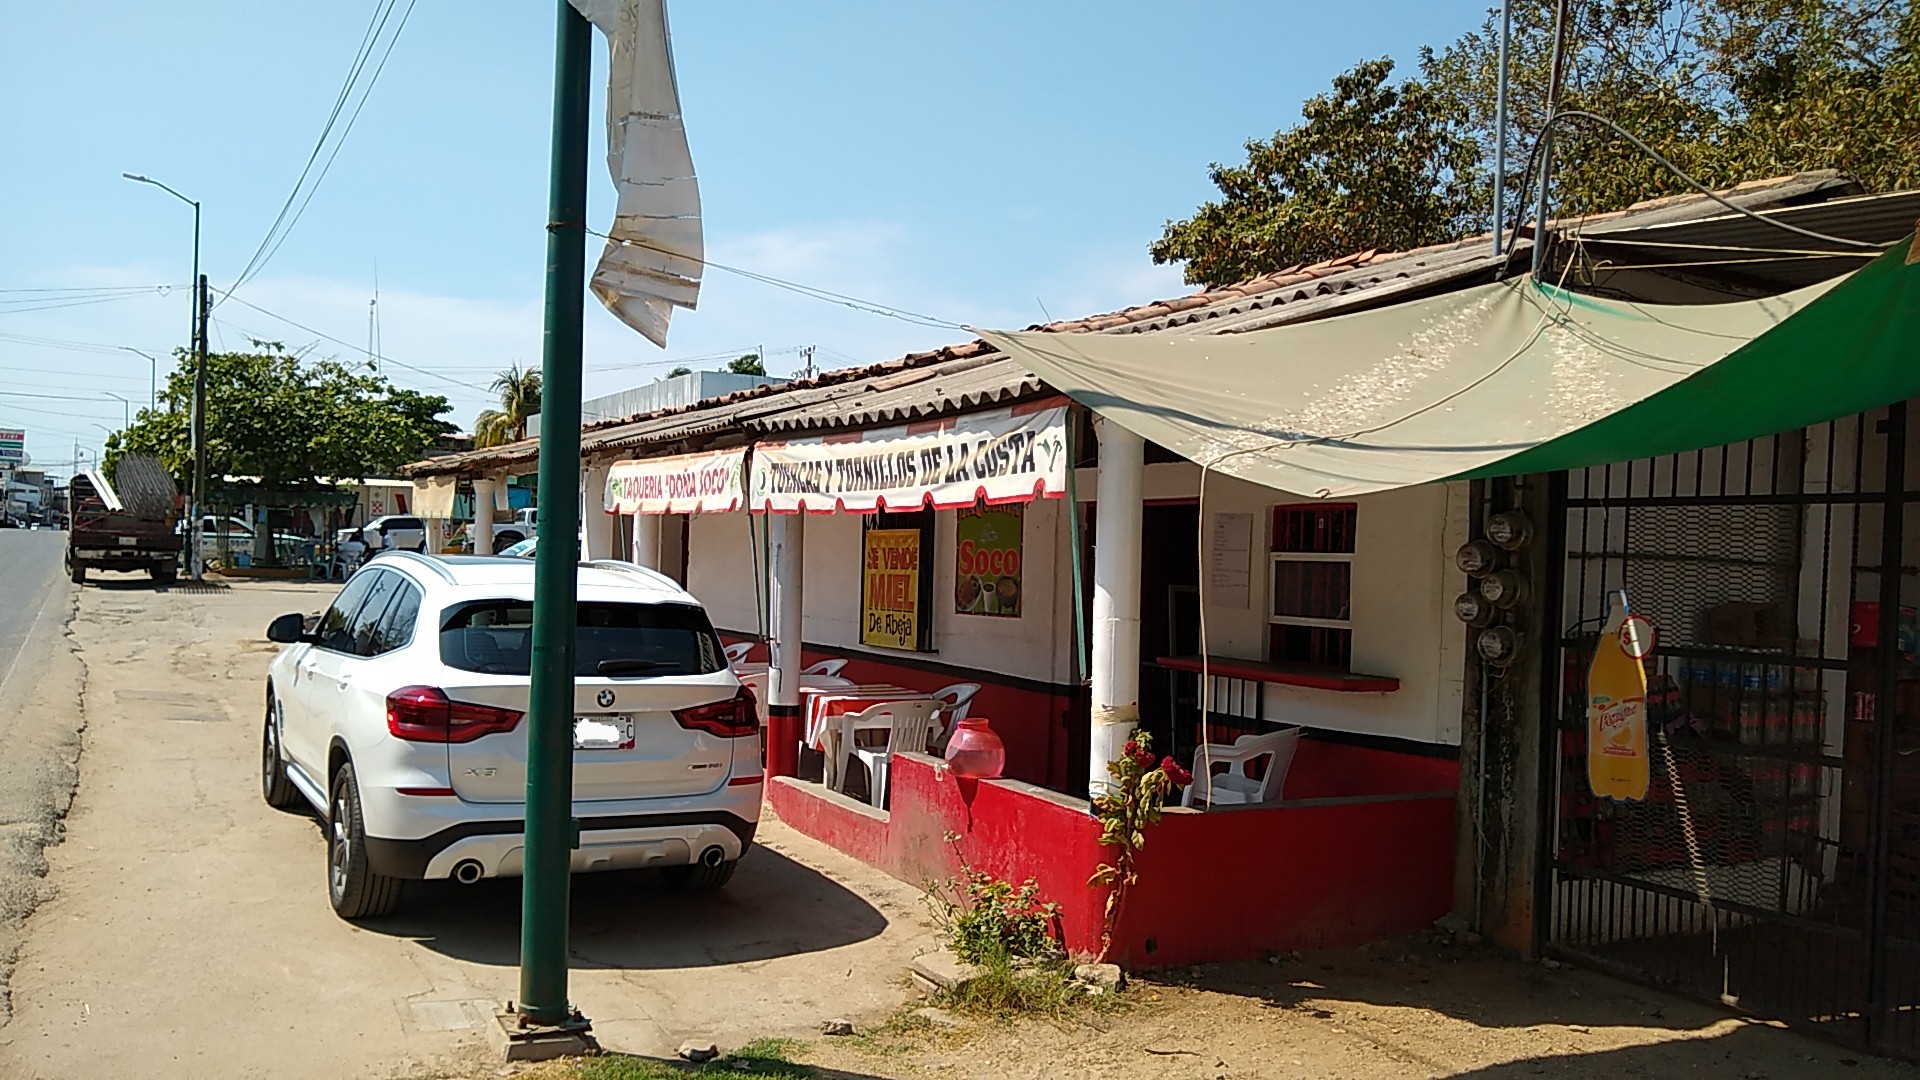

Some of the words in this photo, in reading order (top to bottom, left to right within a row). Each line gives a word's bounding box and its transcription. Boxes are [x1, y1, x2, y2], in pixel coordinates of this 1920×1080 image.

[770, 460, 822, 494] TUERCAS
[825, 459, 833, 493] Y
[836, 450, 917, 493] TORNILLOS
[920, 446, 942, 486] DE
[945, 442, 970, 484] LA
[973, 430, 1036, 480] COSTA
[623, 475, 663, 503] TAQUERIA
[867, 545, 879, 570] SE
[882, 546, 919, 571] VENDE
[868, 573, 915, 613] MIEL
[869, 613, 882, 633] De
[885, 614, 912, 646] Abeja
